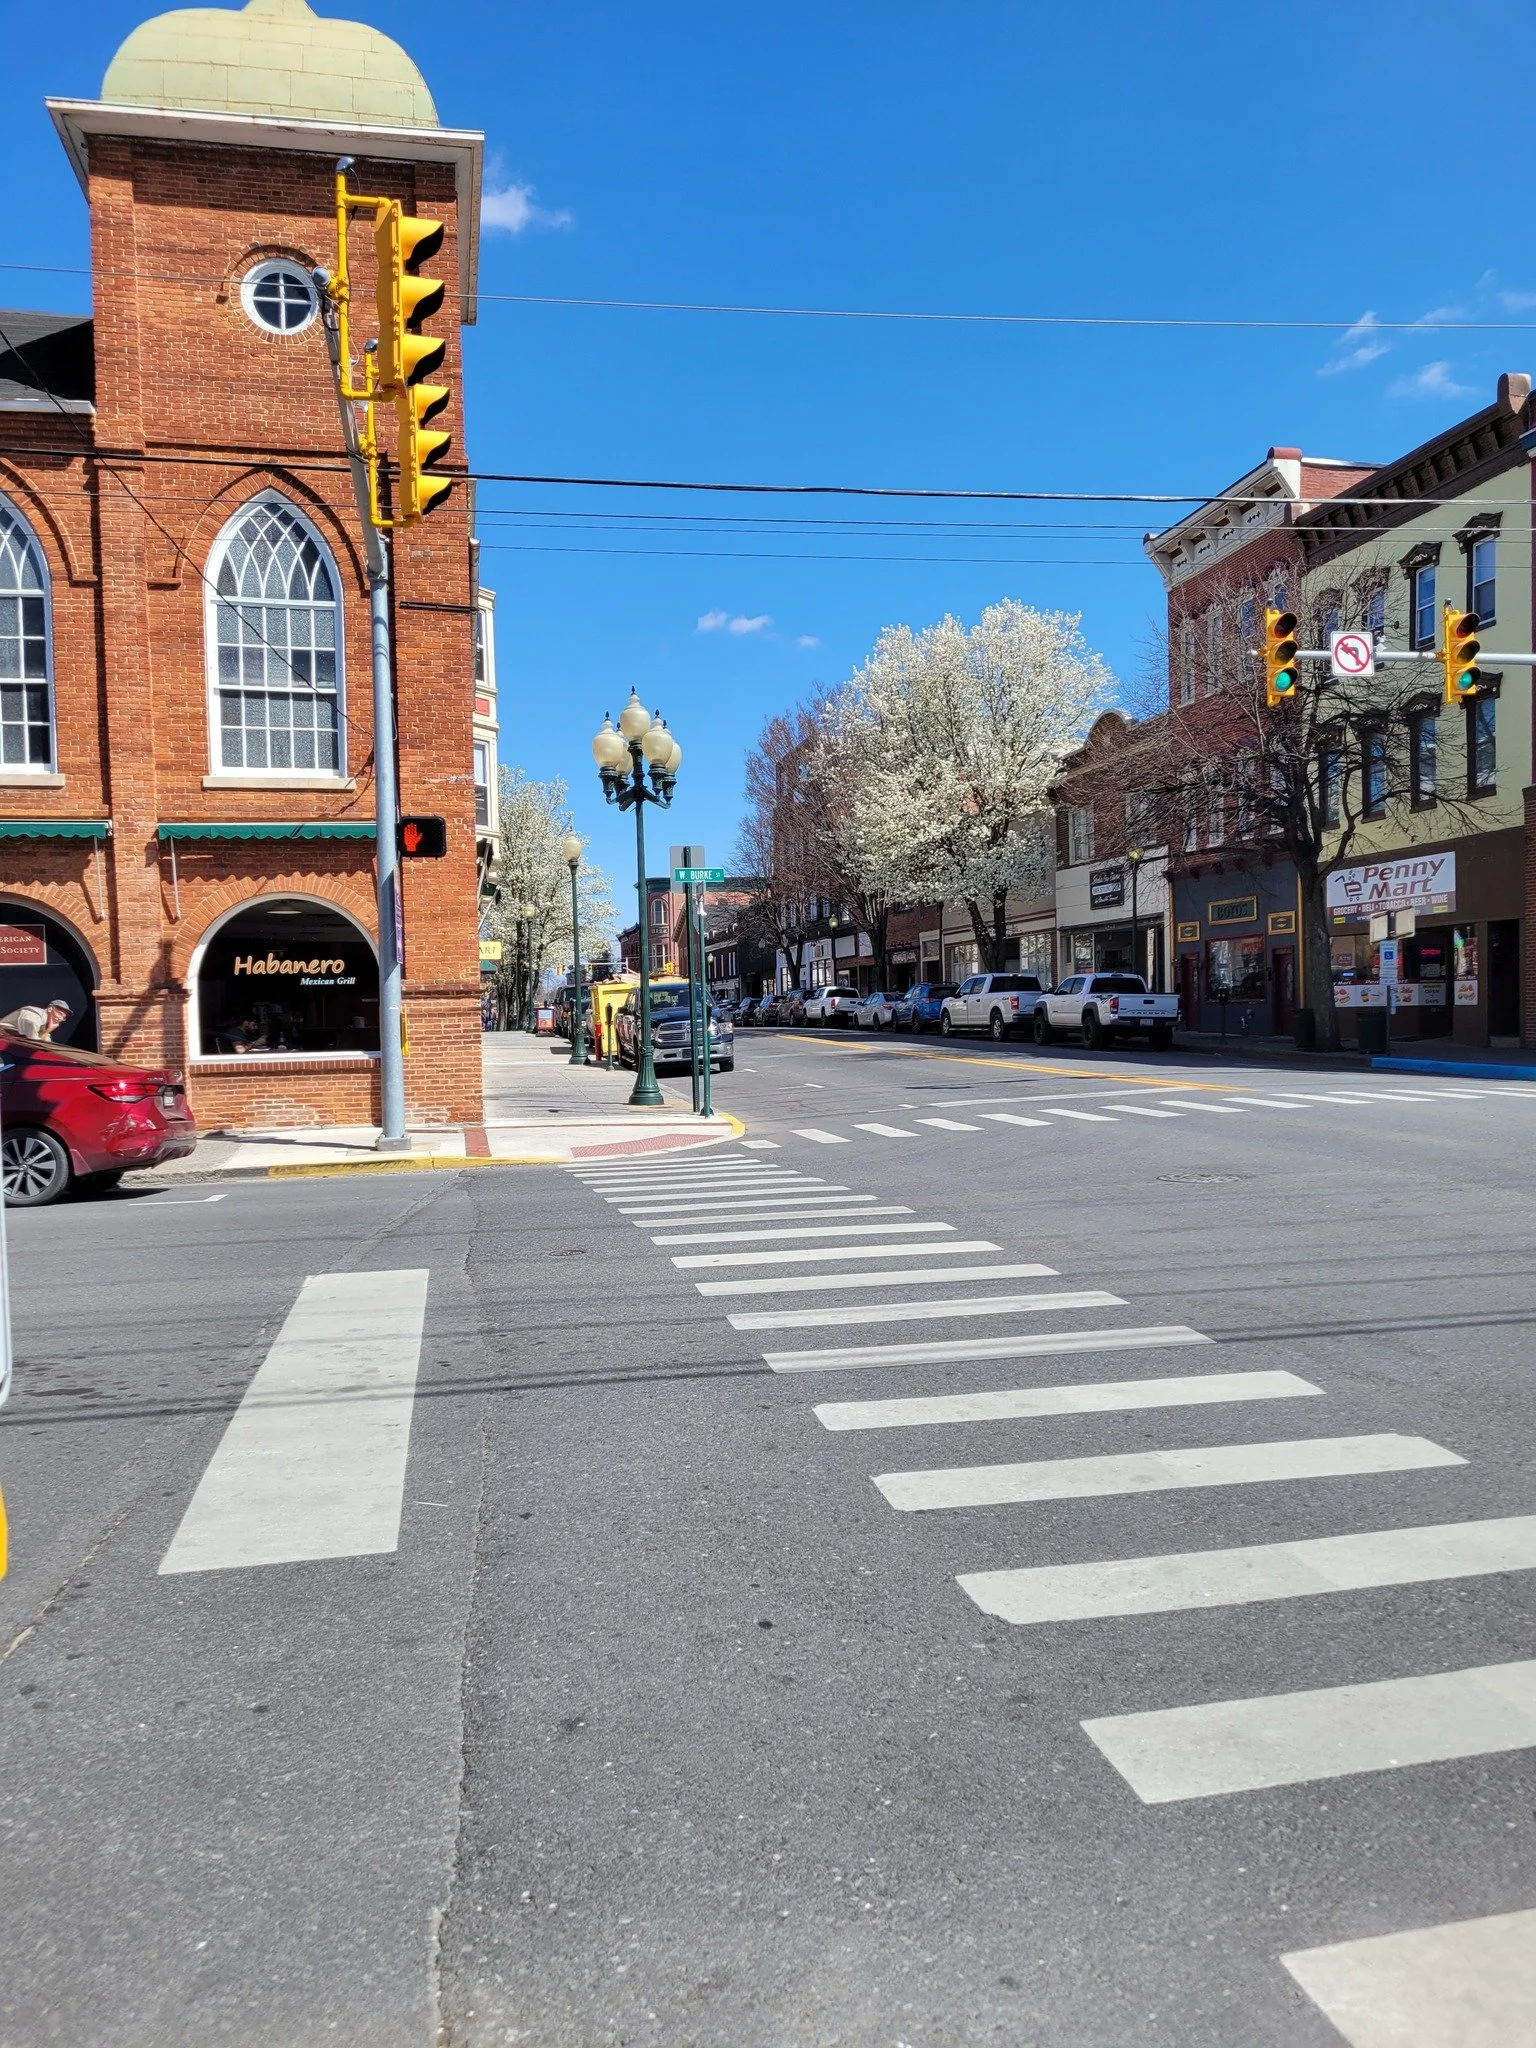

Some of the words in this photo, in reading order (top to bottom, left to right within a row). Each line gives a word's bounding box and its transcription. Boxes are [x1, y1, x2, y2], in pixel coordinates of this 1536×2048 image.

[679, 870, 688, 880] W.
[690, 870, 713, 880] BURKE
[1363, 859, 1445, 883] Penny
[1369, 877, 1433, 900] Mart
[1334, 905, 1358, 916] GROCERY
[1362, 902, 1375, 912] DELI
[1379, 899, 1406, 910] TOBACCO
[1410, 896, 1427, 907] BEER
[1431, 893, 1449, 904] WINE
[0, 946, 40, 954] SOCIETY
[234, 953, 345, 975] Habanero
[300, 977, 335, 986] Mexican
[336, 976, 357, 985] Grill
